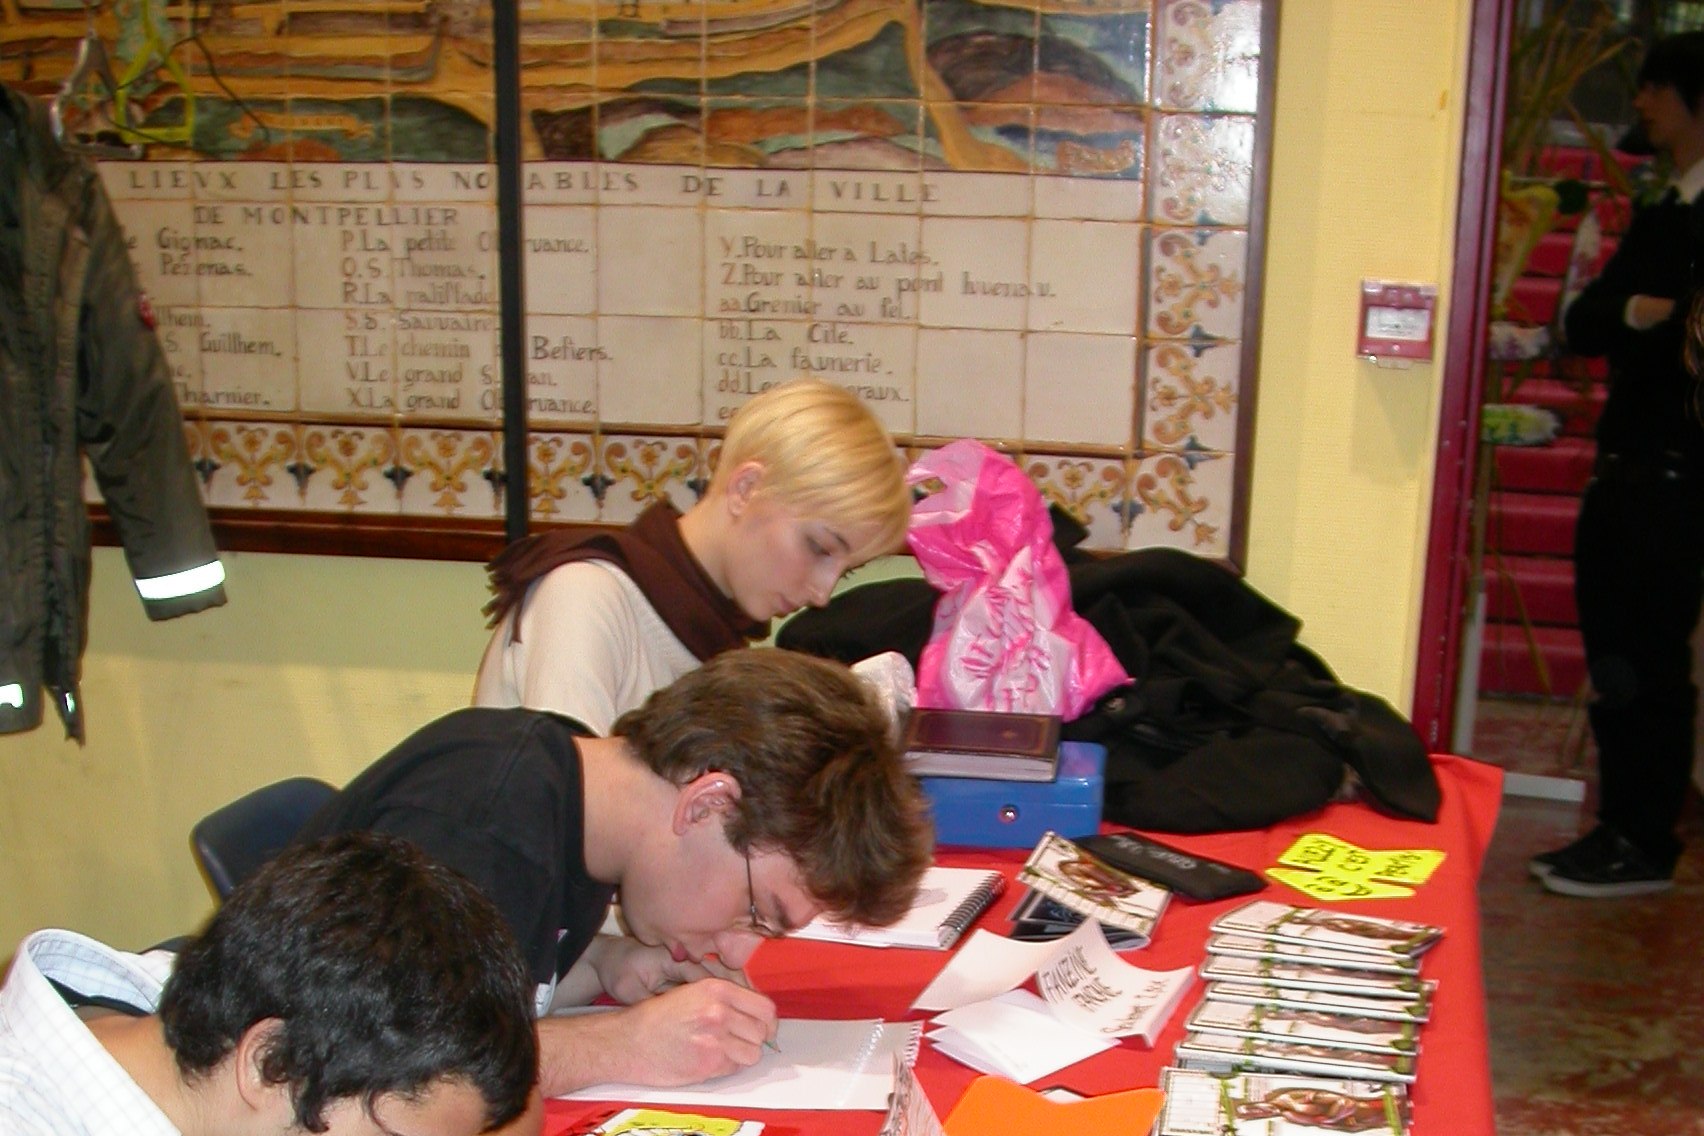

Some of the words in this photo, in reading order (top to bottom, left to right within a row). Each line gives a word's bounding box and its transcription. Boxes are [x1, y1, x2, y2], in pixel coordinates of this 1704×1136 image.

[269, 170, 323, 190] LES
[452, 170, 639, 192] NOABLES
[680, 175, 723, 197] DE
[757, 178, 792, 198] LA
[829, 181, 941, 203] VILLE
[193, 205, 225, 225] DE
[242, 205, 458, 227] MONTPELLIER
